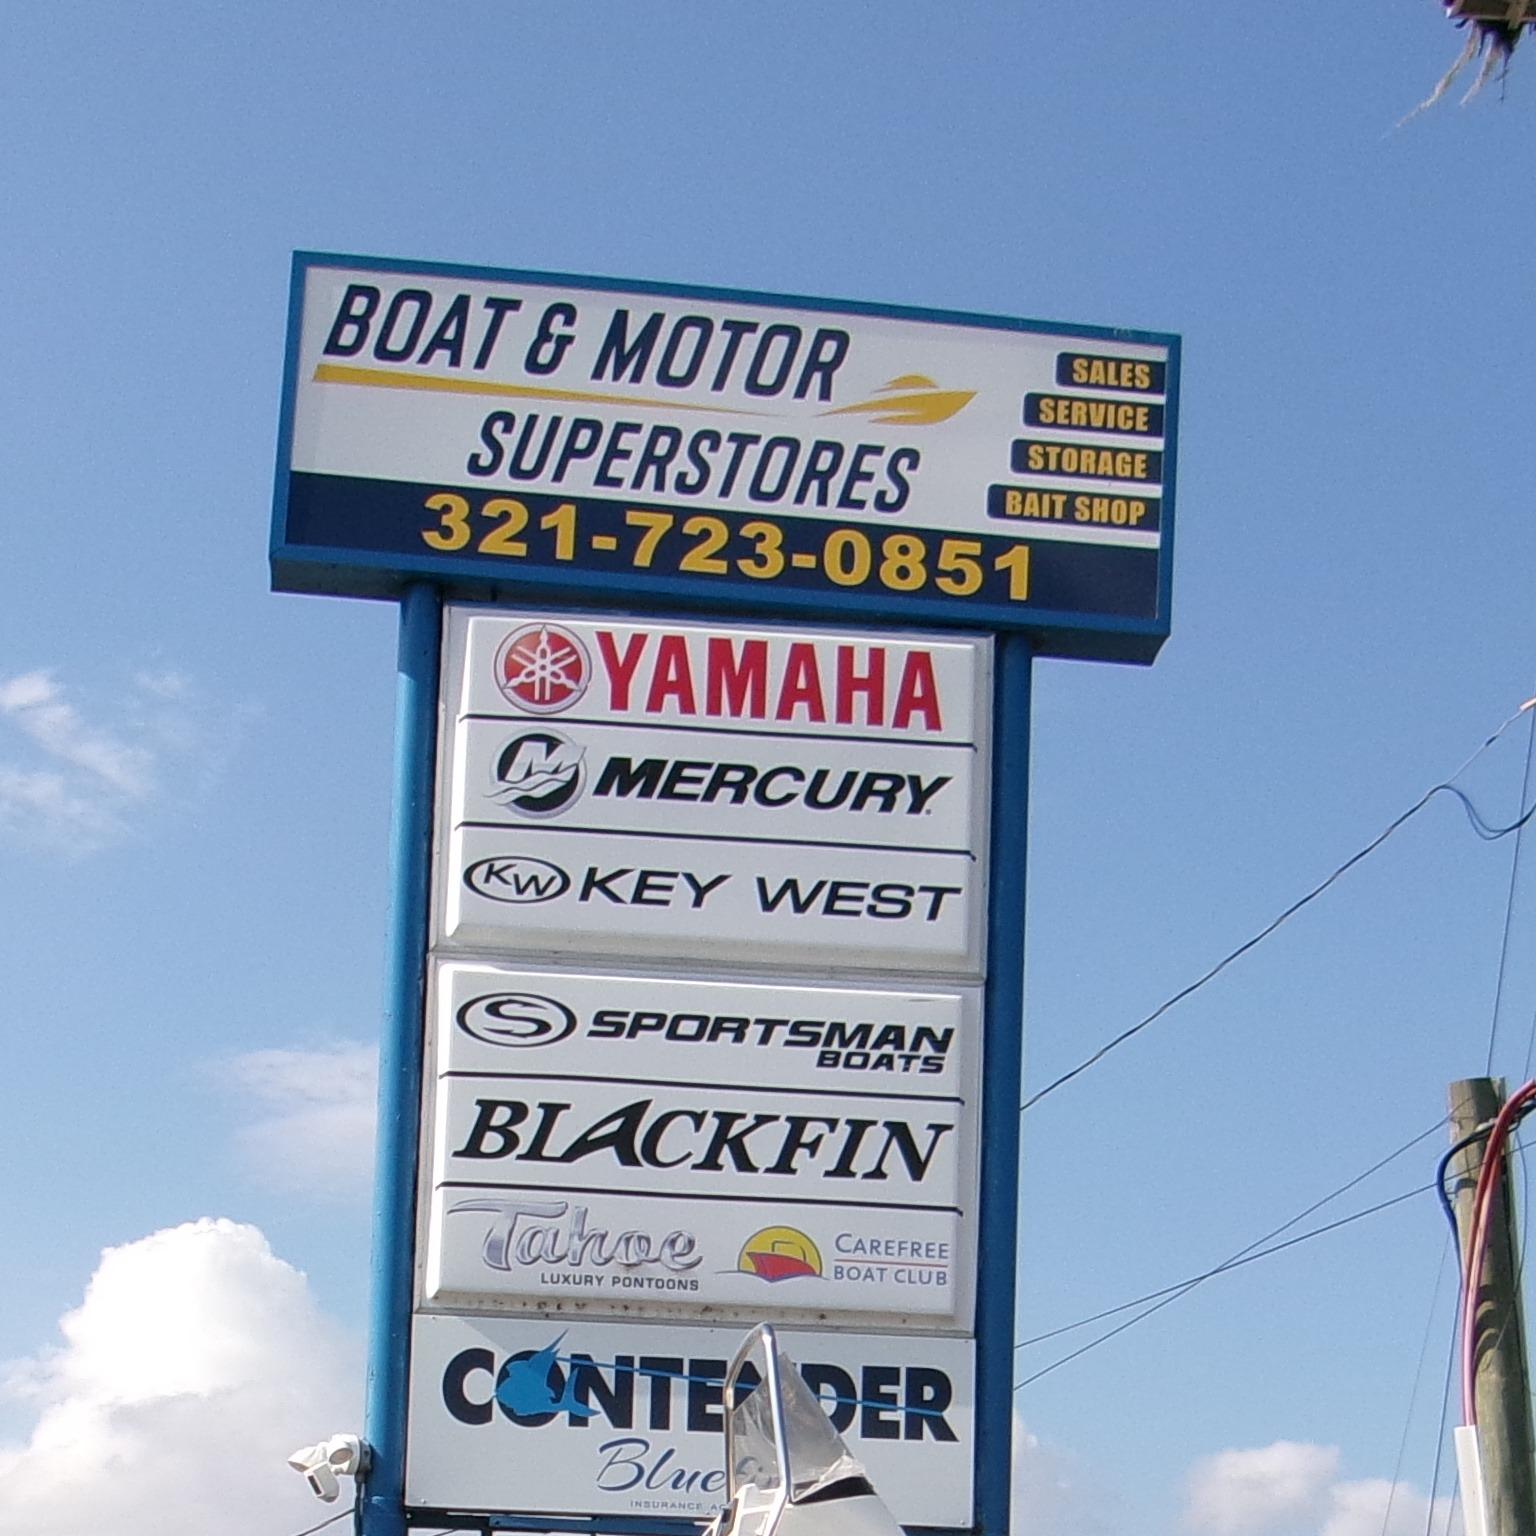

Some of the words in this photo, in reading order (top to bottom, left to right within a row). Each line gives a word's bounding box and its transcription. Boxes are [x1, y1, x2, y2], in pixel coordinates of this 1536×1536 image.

[324, 285, 521, 371] BOAT
[526, 302, 577, 376] &
[593, 309, 851, 402] MOTOR
[1072, 357, 1151, 389] SALES
[1039, 398, 1149, 432] SERVICE
[467, 411, 923, 514] SUPERSTORES
[1027, 444, 1147, 479] STORAGE
[1005, 490, 1067, 520] BAIT
[1074, 496, 1146, 526] SHOP
[421, 493, 1033, 601] 321-723-0851
[595, 631, 943, 732] YAMAHA
[593, 756, 953, 816] MERCURY
[483, 862, 557, 897] KW
[578, 866, 735, 909] KEY
[756, 877, 962, 922] WEST
[586, 1010, 954, 1054] SPORTSMAN
[816, 1050, 946, 1074] BOATS
[452, 1097, 954, 1182] BLACKFIN
[447, 1199, 703, 1271] Tahoe
[834, 1233, 950, 1260] CAREFREE
[540, 1272, 605, 1288] LUXURY
[611, 1276, 700, 1292] PONTOONS
[834, 1266, 888, 1284] BOAT
[894, 1268, 948, 1287] CLUB
[597, 1437, 726, 1492] Blue
[629, 1500, 703, 1511] INSURANCE
